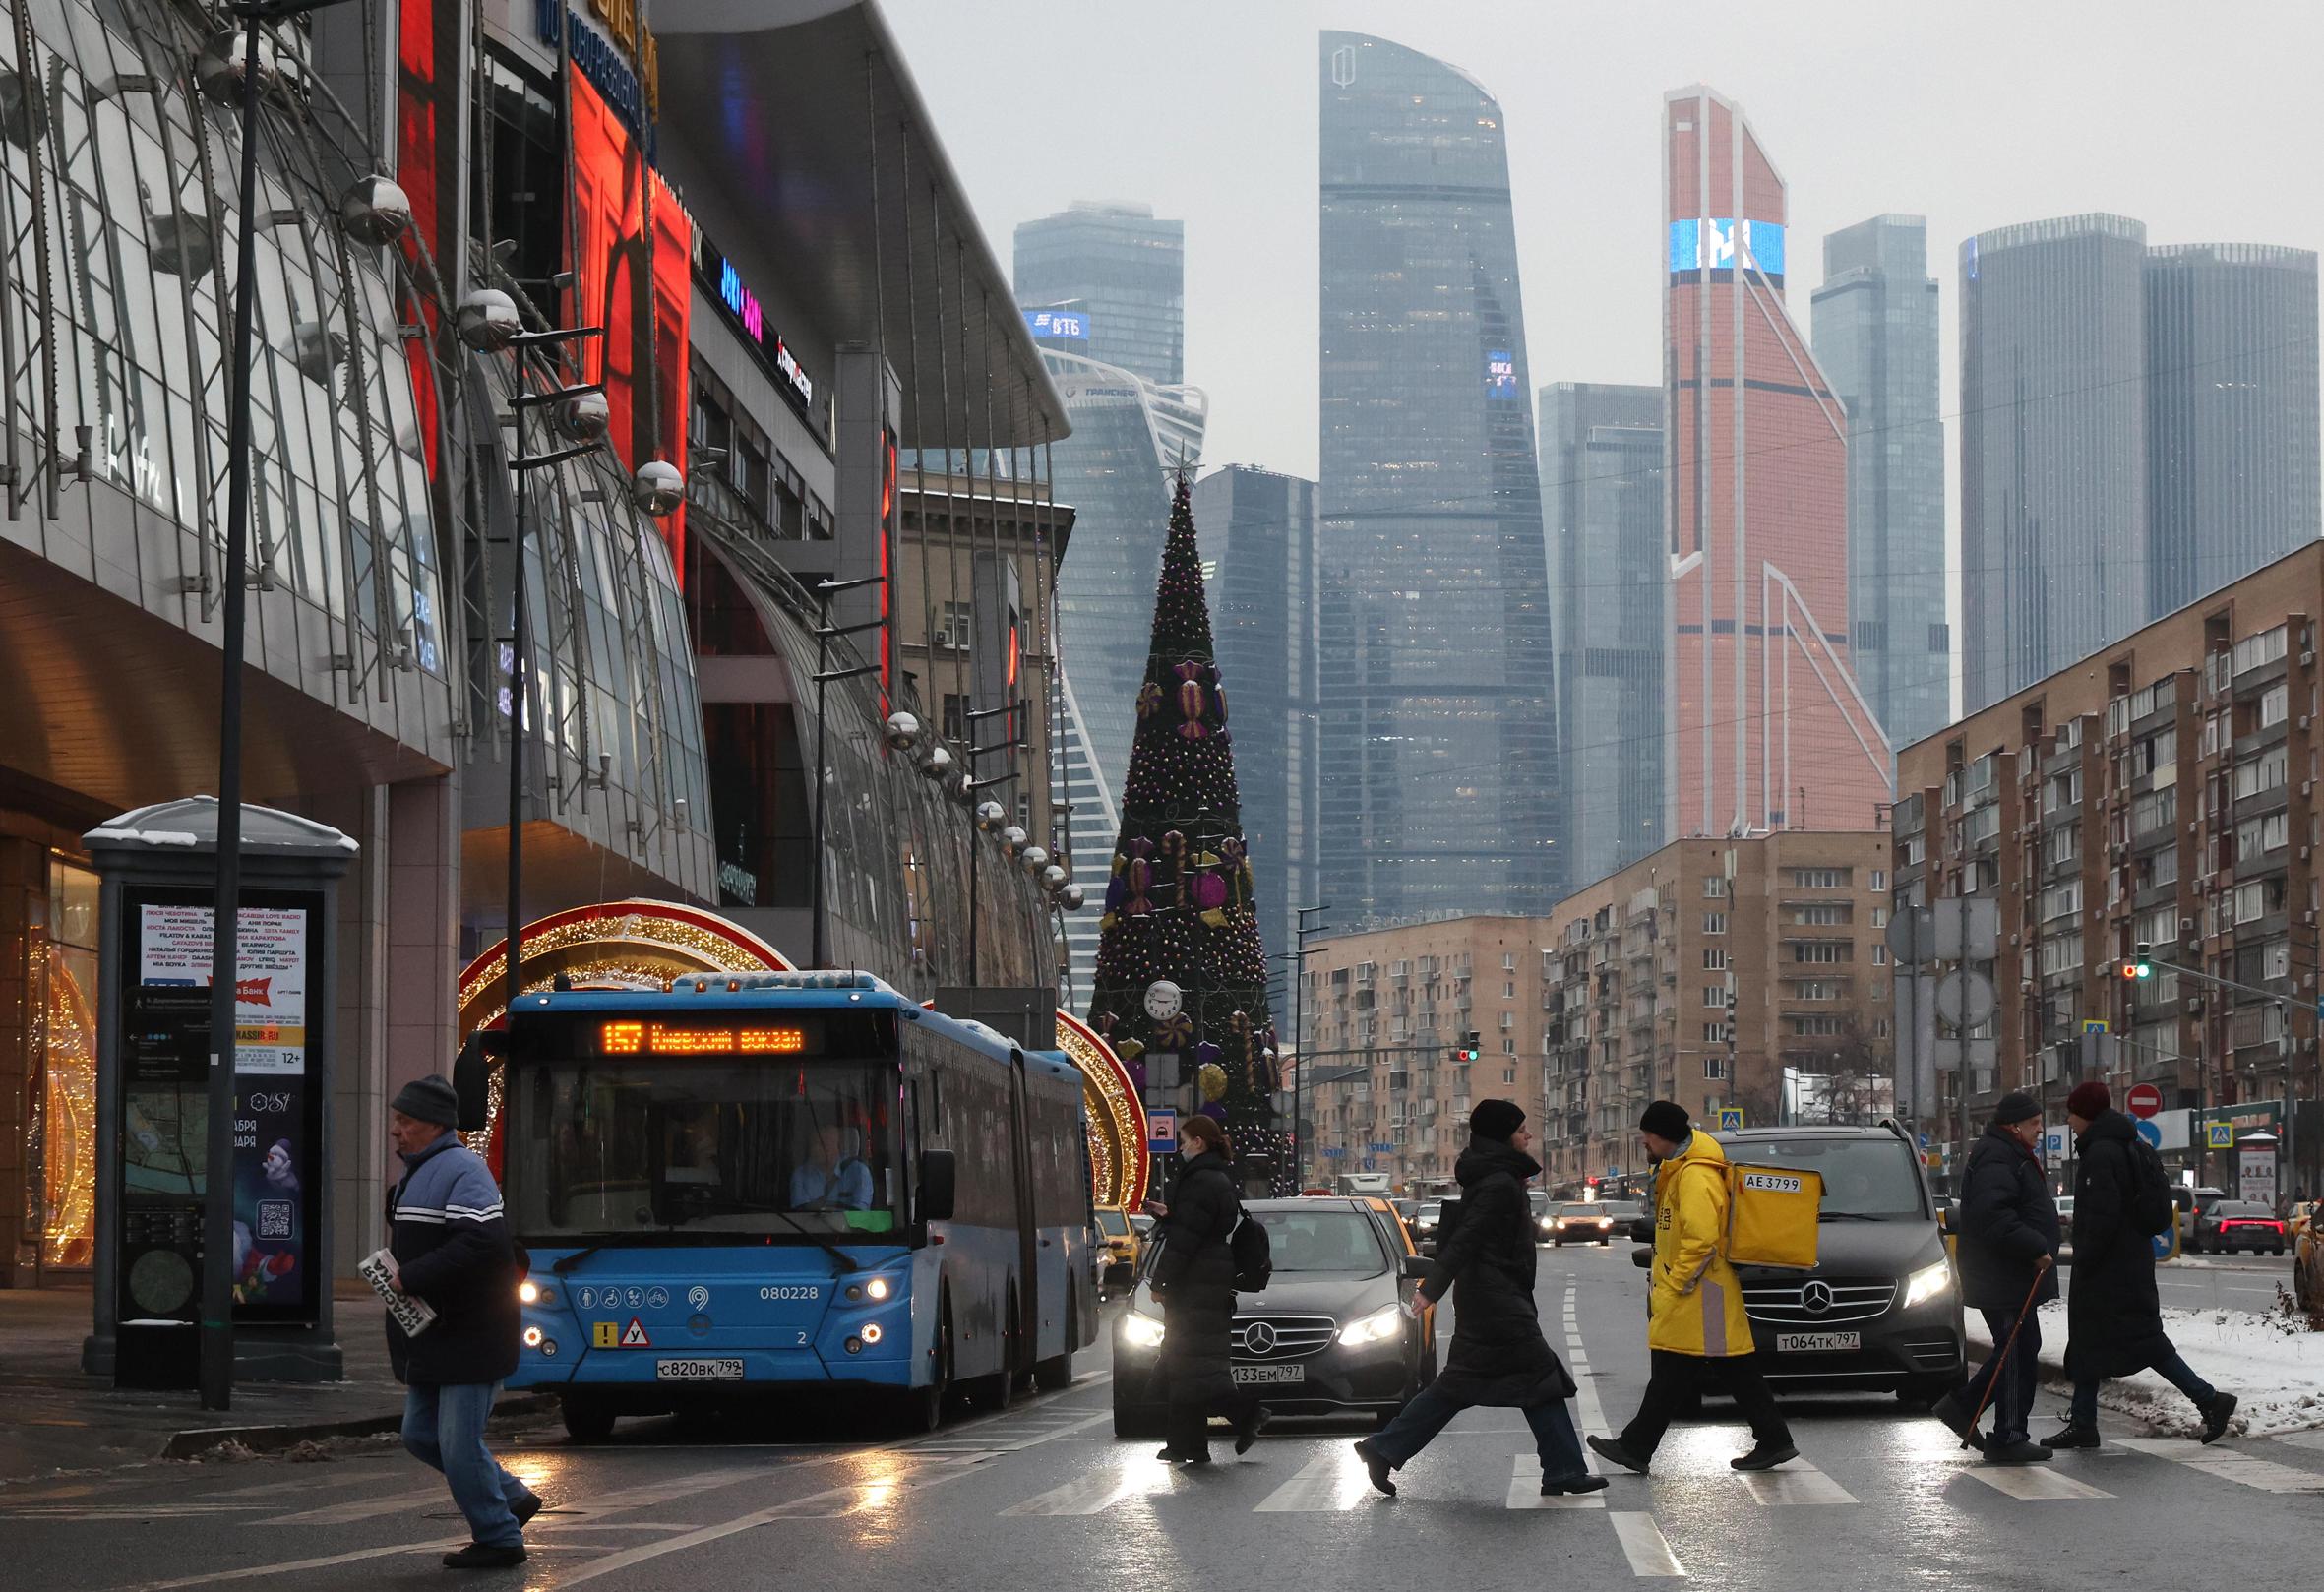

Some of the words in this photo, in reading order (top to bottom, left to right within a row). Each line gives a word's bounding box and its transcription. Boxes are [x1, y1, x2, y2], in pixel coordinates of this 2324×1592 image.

[1052, 318, 1080, 336] ВТБ
[243, 985, 265, 995] Банк
[605, 1024, 642, 1051] 157
[651, 1024, 732, 1050] Киевский
[741, 1031, 801, 1049] вокзал
[281, 1052, 301, 1064] 12+
[1663, 1208, 1672, 1231] Еда
[362, 1265, 416, 1332] КРАСНАЯ
[374, 1258, 423, 1325] КНОКА
[760, 1287, 819, 1300] 080228
[797, 1331, 807, 1345] 2
[1782, 1335, 1834, 1349] Т064ТК
[1836, 1333, 1857, 1344] 797
[661, 1362, 715, 1377] С820ВК
[717, 1361, 740, 1374] 799
[1279, 1365, 1300, 1377] 797
